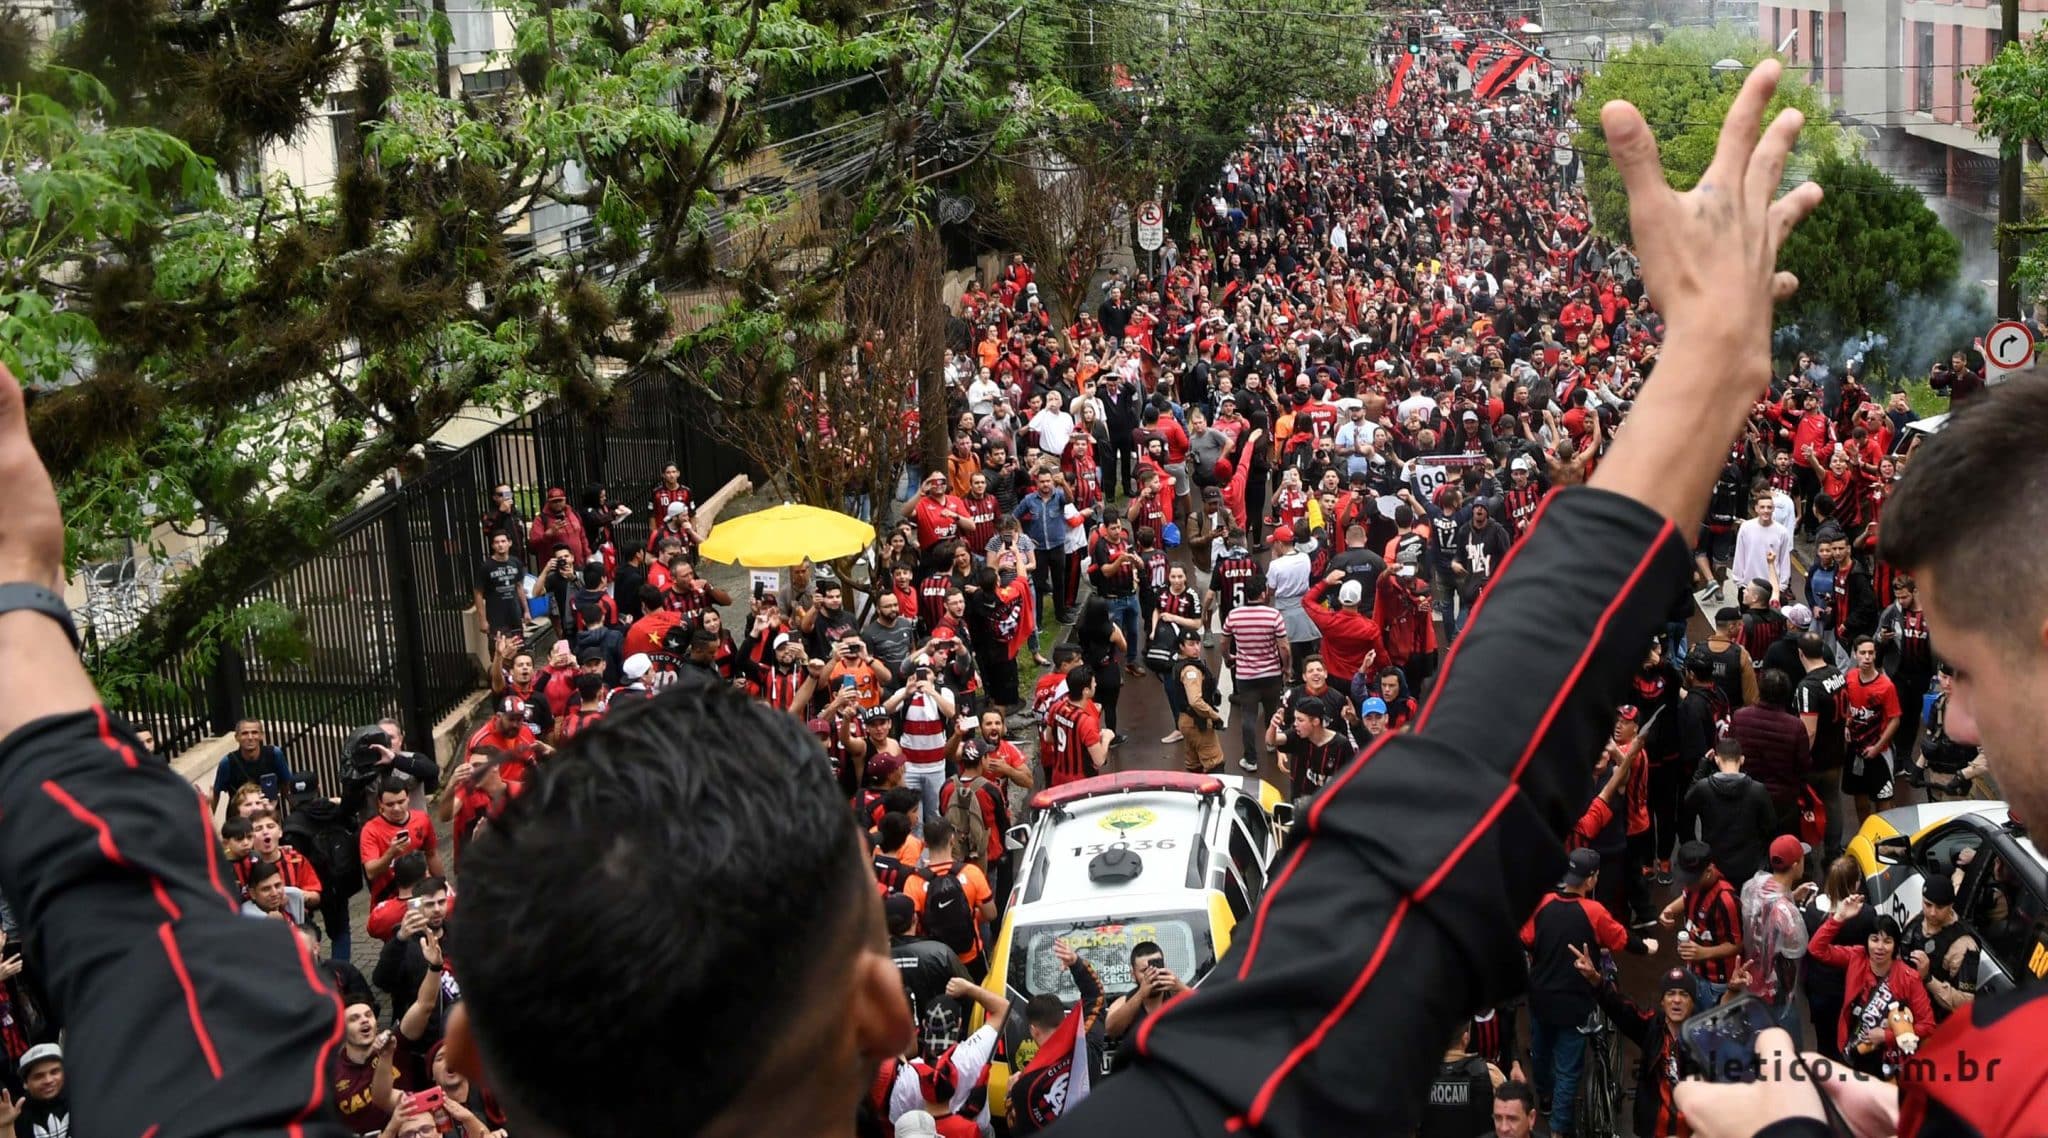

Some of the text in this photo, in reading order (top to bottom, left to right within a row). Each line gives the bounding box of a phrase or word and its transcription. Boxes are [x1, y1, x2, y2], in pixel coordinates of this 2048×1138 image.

[660, 496, 670, 506] 10
[1437, 528, 1458, 548] 12
[1225, 569, 1252, 578] CAIXA
[1233, 582, 1245, 607] 5
[1056, 726, 1067, 752] 9
[1070, 839, 1176, 858] 13036
[1892, 892, 1910, 929] PO
[1103, 964, 1131, 974] PARA
[1102, 974, 1132, 985] SEGU
[1431, 1084, 1469, 1103] ROCAM
